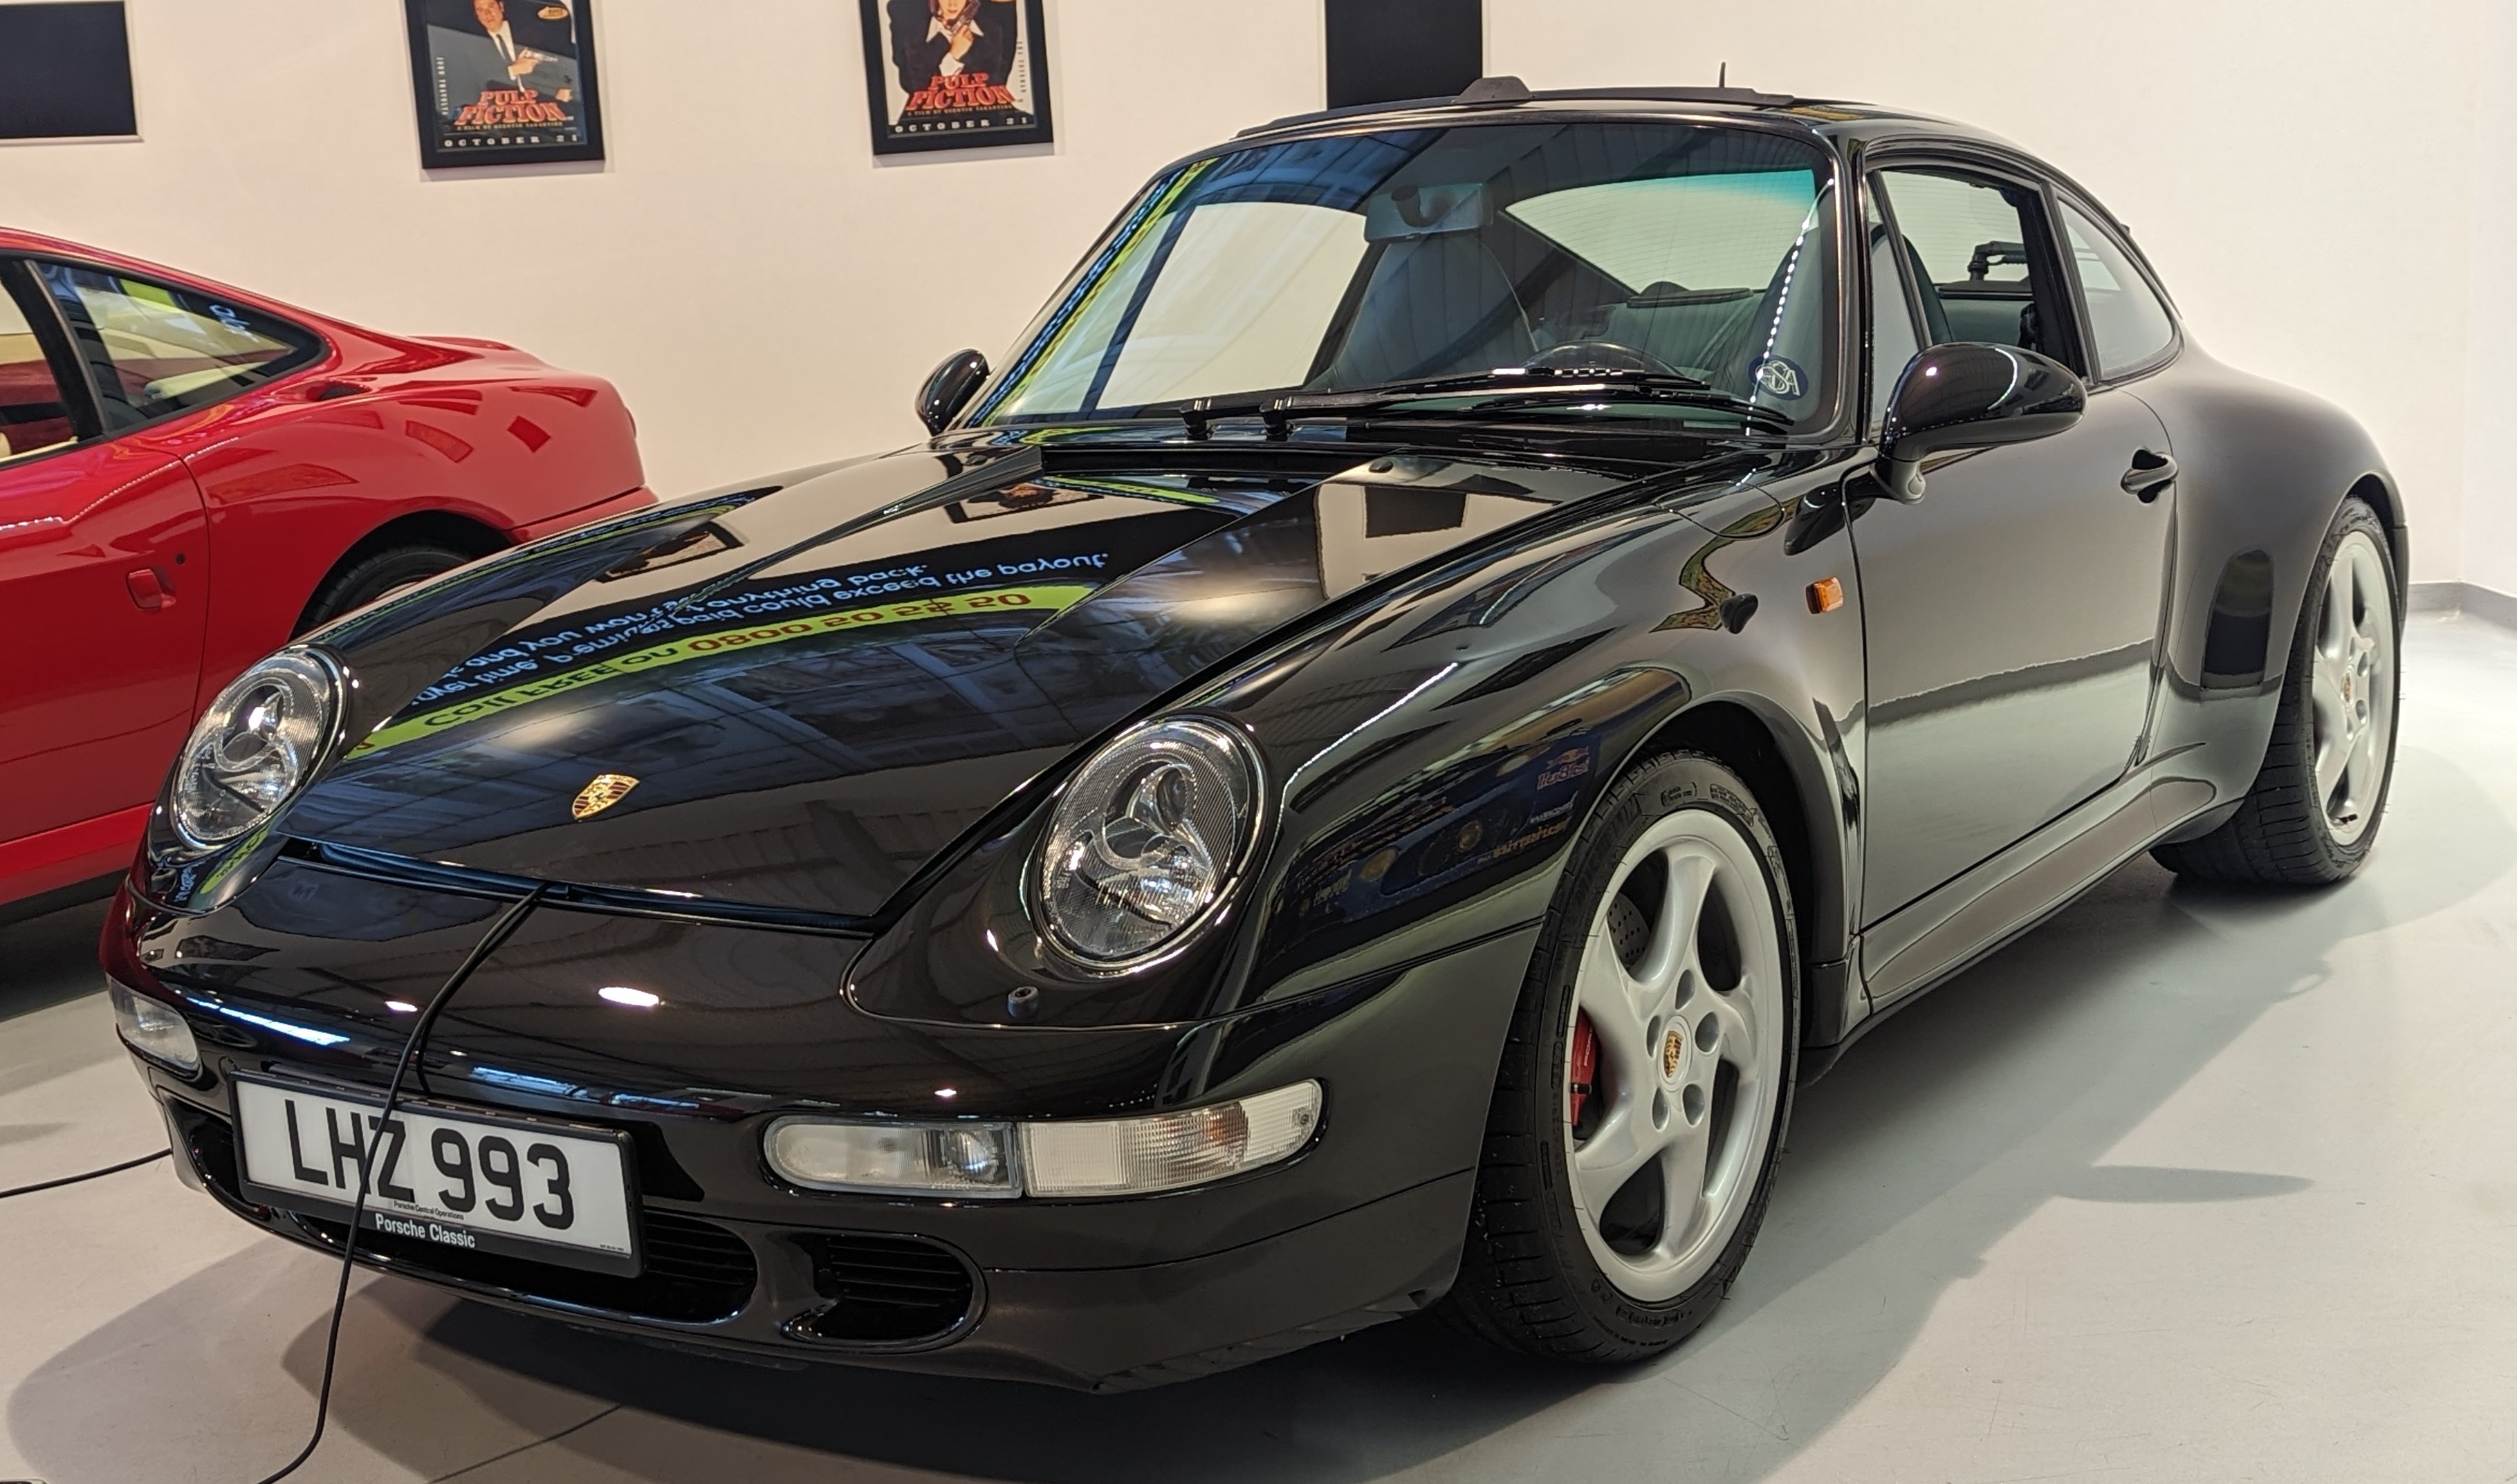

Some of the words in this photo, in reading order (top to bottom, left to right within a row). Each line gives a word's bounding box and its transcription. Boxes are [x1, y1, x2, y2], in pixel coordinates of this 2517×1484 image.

[930, 72, 989, 90] PULP
[479, 89, 538, 105] PULP
[905, 84, 1016, 111] FICTION
[454, 102, 566, 125] FICTION
[895, 119, 990, 133] OCTOBER
[444, 136, 540, 147] OCTOBER
[556, 134, 577, 142] 21
[284, 1099, 415, 1203] LHZ
[431, 1127, 575, 1230] 993
[394, 1200, 415, 1211] Porsche
[415, 1204, 434, 1214] Central
[435, 1208, 464, 1221] Operations
[375, 1212, 425, 1239] Porsche
[429, 1223, 476, 1248] Classic
